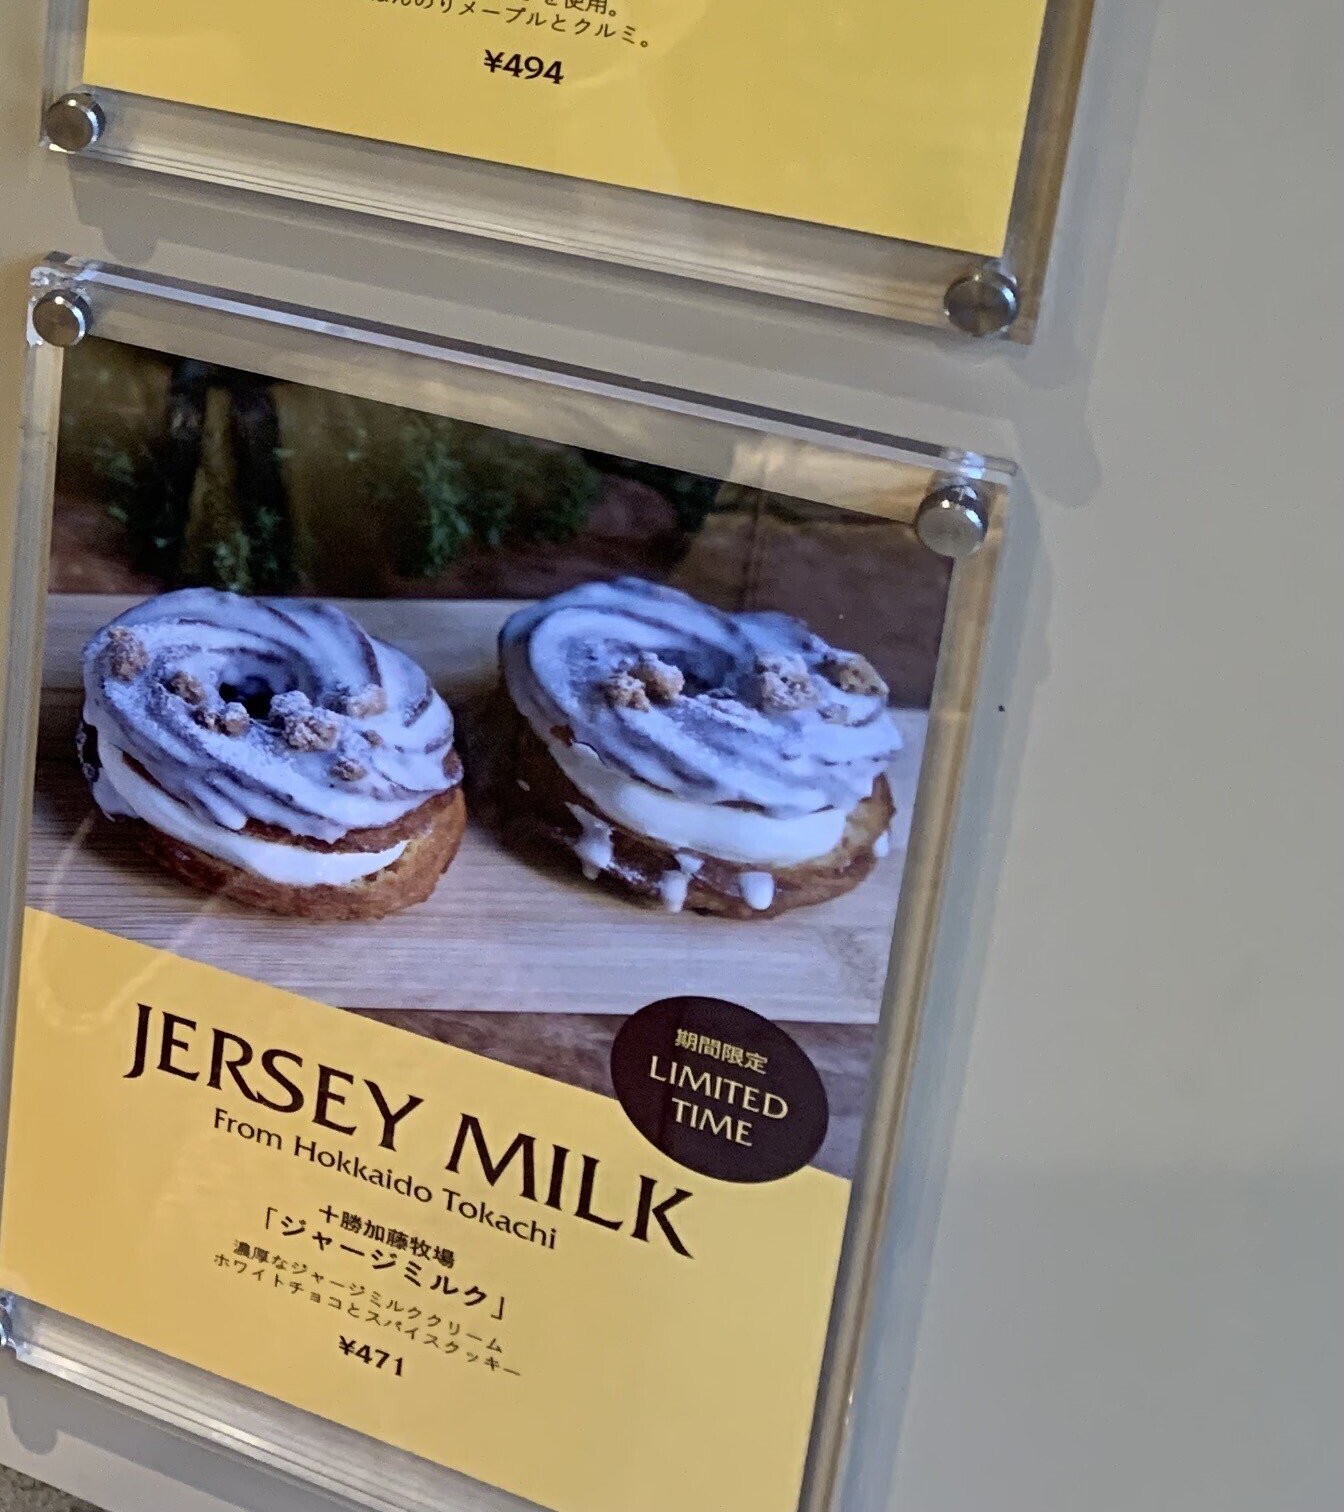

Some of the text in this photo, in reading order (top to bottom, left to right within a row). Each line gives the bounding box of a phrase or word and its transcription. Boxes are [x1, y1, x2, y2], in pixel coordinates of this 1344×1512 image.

[483, 49, 565, 85] ¥494
[674, 1028, 769, 1075] 期間限定
[649, 1055, 790, 1119] LIMITED
[122, 1002, 698, 1259] JERSEY MILK
[672, 1097, 753, 1147] TIME
[213, 1107, 558, 1251] From Hokkaido Tokachi
[265, 1206, 505, 1321] 「ジャージミルク」
[318, 1204, 456, 1269] 十勝加藤牧場
[338, 1335, 405, 1377] ¥471
